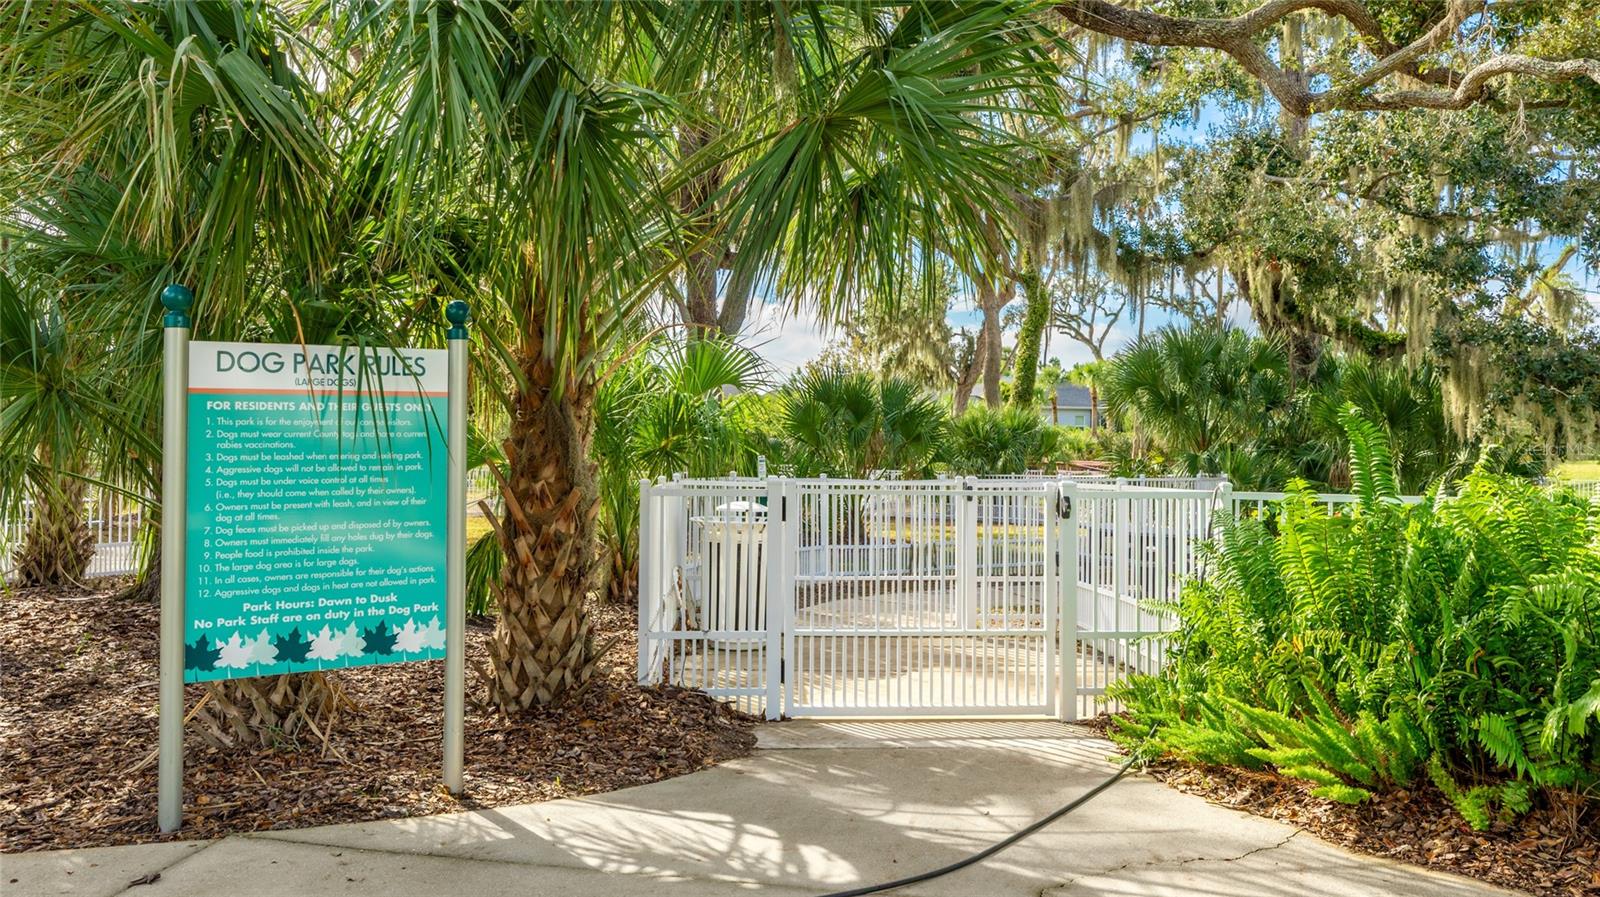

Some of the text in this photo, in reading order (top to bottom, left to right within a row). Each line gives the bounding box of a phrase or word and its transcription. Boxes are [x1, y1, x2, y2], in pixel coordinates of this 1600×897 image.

[216, 350, 285, 374] DOG
[293, 352, 356, 375] PARK
[207, 401, 231, 410] FOR
[235, 402, 296, 411] RESIDENTS
[299, 402, 325, 411] AND
[217, 416, 291, 427] This park is for the
[217, 429, 238, 440] Dogs
[240, 430, 259, 438] must
[284, 430, 311, 438] current
[360, 430, 375, 438] and
[216, 441, 242, 449] rabies
[217, 452, 238, 463] Dogs
[240, 452, 259, 461] must
[261, 452, 272, 461] be
[274, 452, 304, 460] leashed
[306, 452, 327, 460] when
[362, 451, 376, 460] and
[216, 464, 261, 475] Aggressive
[264, 464, 283, 474] dogs
[285, 463, 300, 472] will
[302, 463, 314, 472] not
[316, 463, 327, 472] be
[359, 463, 367, 472] to
[396, 462, 404, 471] in
[216, 476, 238, 488] Dogs
[239, 476, 260, 486] must
[260, 476, 272, 485] be
[273, 476, 297, 485] under
[298, 475, 320, 484] voice
[320, 475, 348, 484] control
[348, 475, 357, 484] at
[358, 475, 368, 483] all
[237, 488, 255, 500] they
[256, 488, 284, 497] should
[308, 487, 330, 496] when
[331, 487, 355, 496] called
[355, 486, 366, 497] by
[368, 486, 384, 495] their
[215, 501, 249, 511] Owners
[250, 501, 270, 510] must
[270, 500, 282, 509] be
[283, 500, 313, 511] present
[313, 499, 331, 508] with
[356, 498, 372, 507] and
[374, 498, 381, 507] in
[382, 498, 400, 506] view
[401, 498, 409, 506] of
[410, 497, 427, 506] their
[215, 513, 233, 524] dog
[234, 512, 244, 522] at
[244, 512, 256, 521] all
[215, 525, 234, 536] Dog
[235, 524, 256, 534] feces
[258, 523, 277, 533] must
[279, 523, 289, 532] be
[291, 522, 317, 533] picked
[319, 524, 329, 532] up
[331, 521, 346, 530] and
[348, 520, 382, 531] disposed
[383, 520, 391, 528] of
[392, 519, 402, 530] by
[215, 536, 248, 547] Owners
[249, 535, 269, 545] must
[271, 534, 318, 546] immediately
[332, 535, 346, 544] any
[348, 532, 367, 542] holes
[370, 531, 384, 542] dug
[386, 531, 395, 542] by
[397, 530, 413, 540] their
[215, 549, 244, 561] People
[244, 548, 264, 558] food
[266, 547, 273, 557] is
[274, 546, 316, 558] prohibited
[317, 545, 340, 555] inside
[341, 544, 354, 554] the
[214, 562, 231, 572] The
[231, 561, 254, 573] large
[255, 560, 272, 572] dog
[295, 559, 302, 568] is
[303, 558, 315, 568] for
[316, 557, 337, 569] large
[214, 575, 223, 584] In
[224, 574, 236, 583] all
[310, 568, 354, 581] responsible
[356, 568, 366, 576] for
[368, 567, 385, 576] their
[214, 585, 260, 598] Aggressive
[262, 584, 281, 596] dogs
[283, 583, 299, 593] and
[301, 582, 320, 593] dogs
[323, 581, 330, 590] in
[332, 580, 349, 590] heat
[365, 579, 378, 588] not
[409, 577, 417, 585] in
[242, 593, 398, 612] Park Hours: Dawn to Dusk
[194, 603, 439, 628] No Park Staff are on duty in the Dog Park
